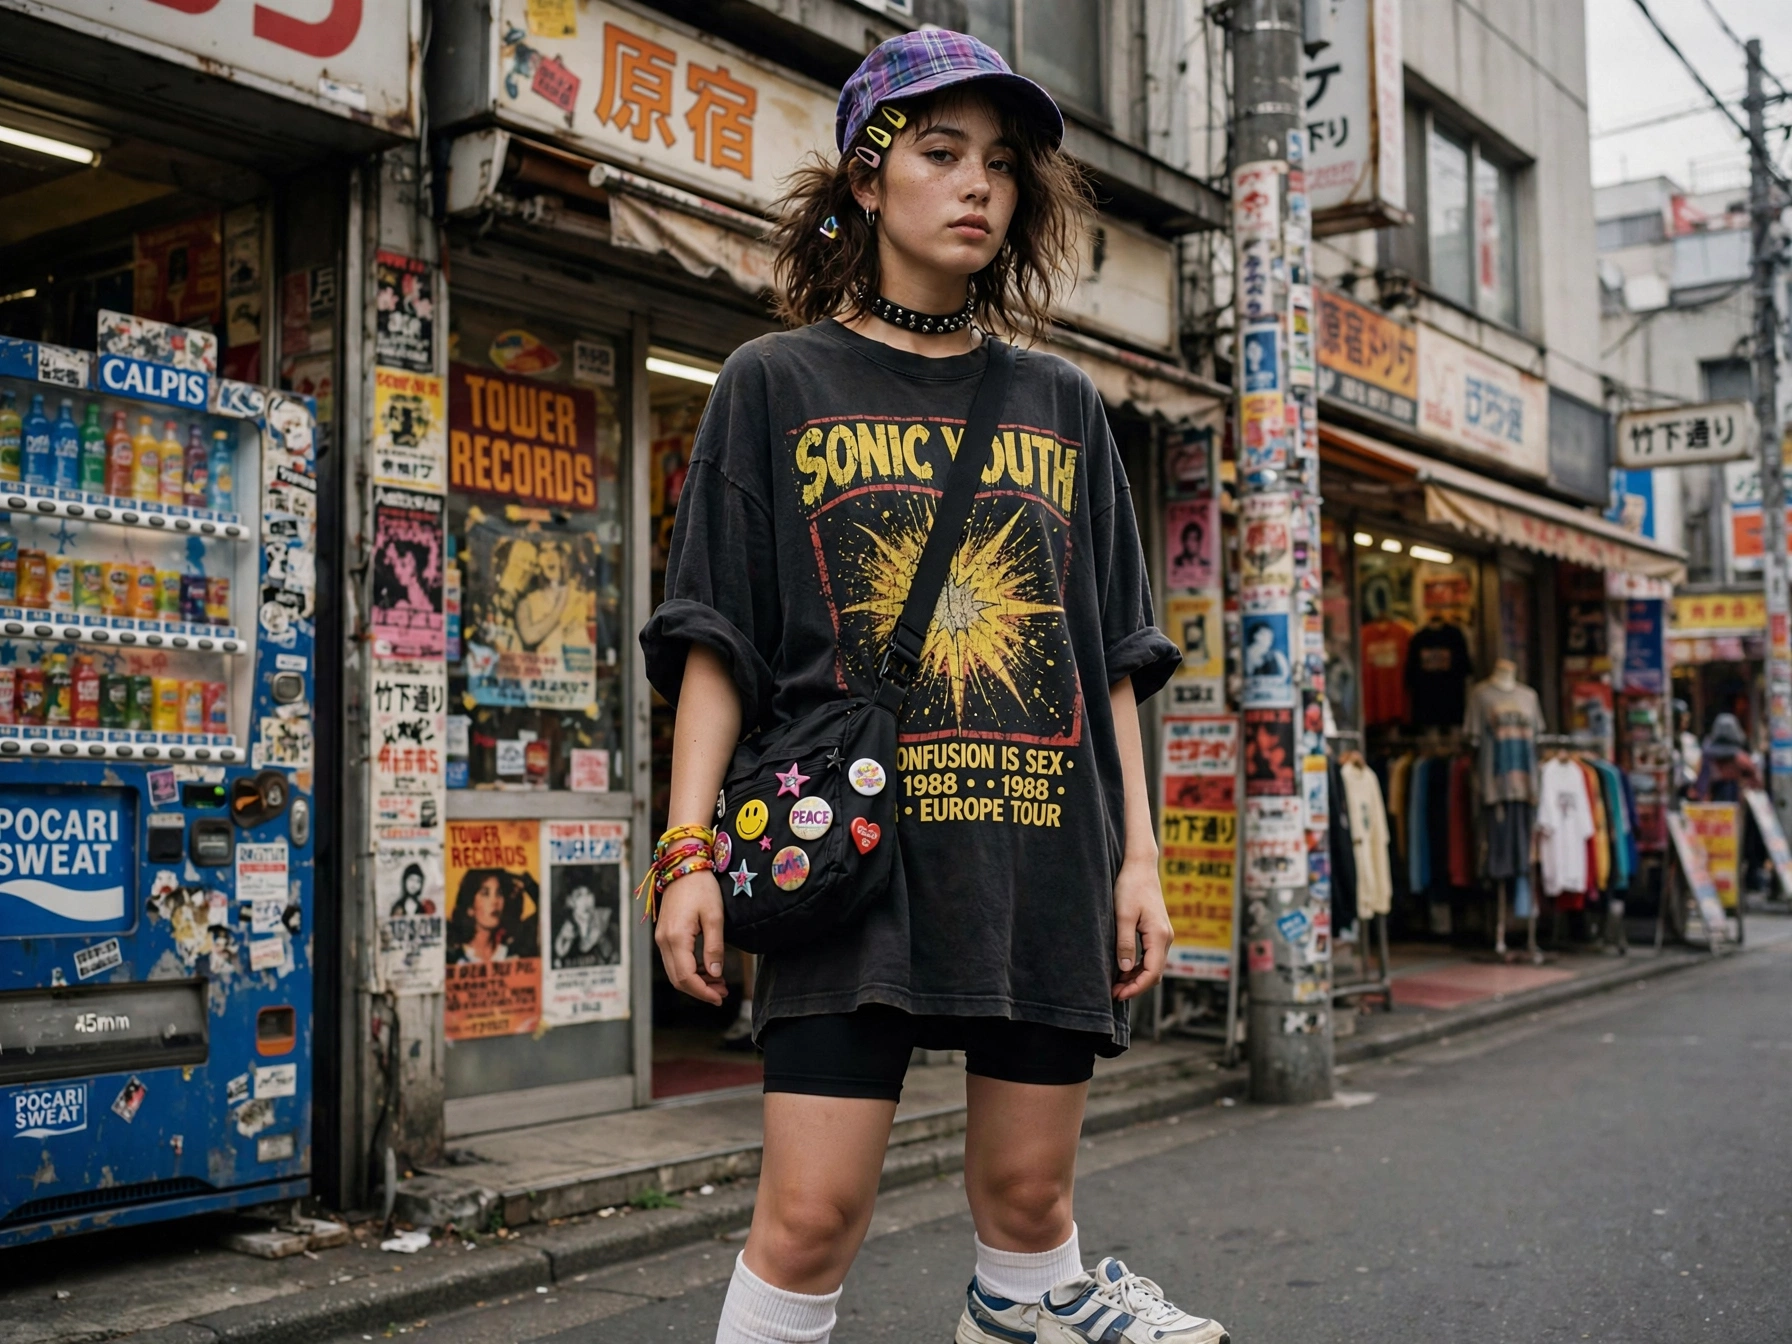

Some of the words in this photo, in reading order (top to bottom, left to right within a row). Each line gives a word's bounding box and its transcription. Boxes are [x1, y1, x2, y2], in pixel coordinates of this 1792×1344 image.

[595, 22, 757, 180] 原宿
[103, 359, 206, 405] CALPIS
[465, 374, 578, 447] TOWER
[1630, 415, 1734, 455] 竹下通り
[451, 430, 598, 506] RECORDS
[796, 423, 933, 506] SONIC
[375, 681, 443, 713] 竹下通り
[896, 743, 994, 772] ONFUSION
[1001, 746, 1020, 771] IS
[903, 773, 958, 797] 1988
[1001, 775, 1049, 800] 1988
[0, 808, 119, 841] POCARI
[792, 810, 829, 824] PEACE
[920, 797, 1004, 822] EUROPE
[1010, 800, 1063, 828] TOUR
[450, 824, 500, 843] TOWER
[0, 843, 112, 875] SWEAT
[451, 845, 528, 869] RECORDS
[16, 1088, 83, 1112] POCARI
[16, 1105, 80, 1128] SWEAT
